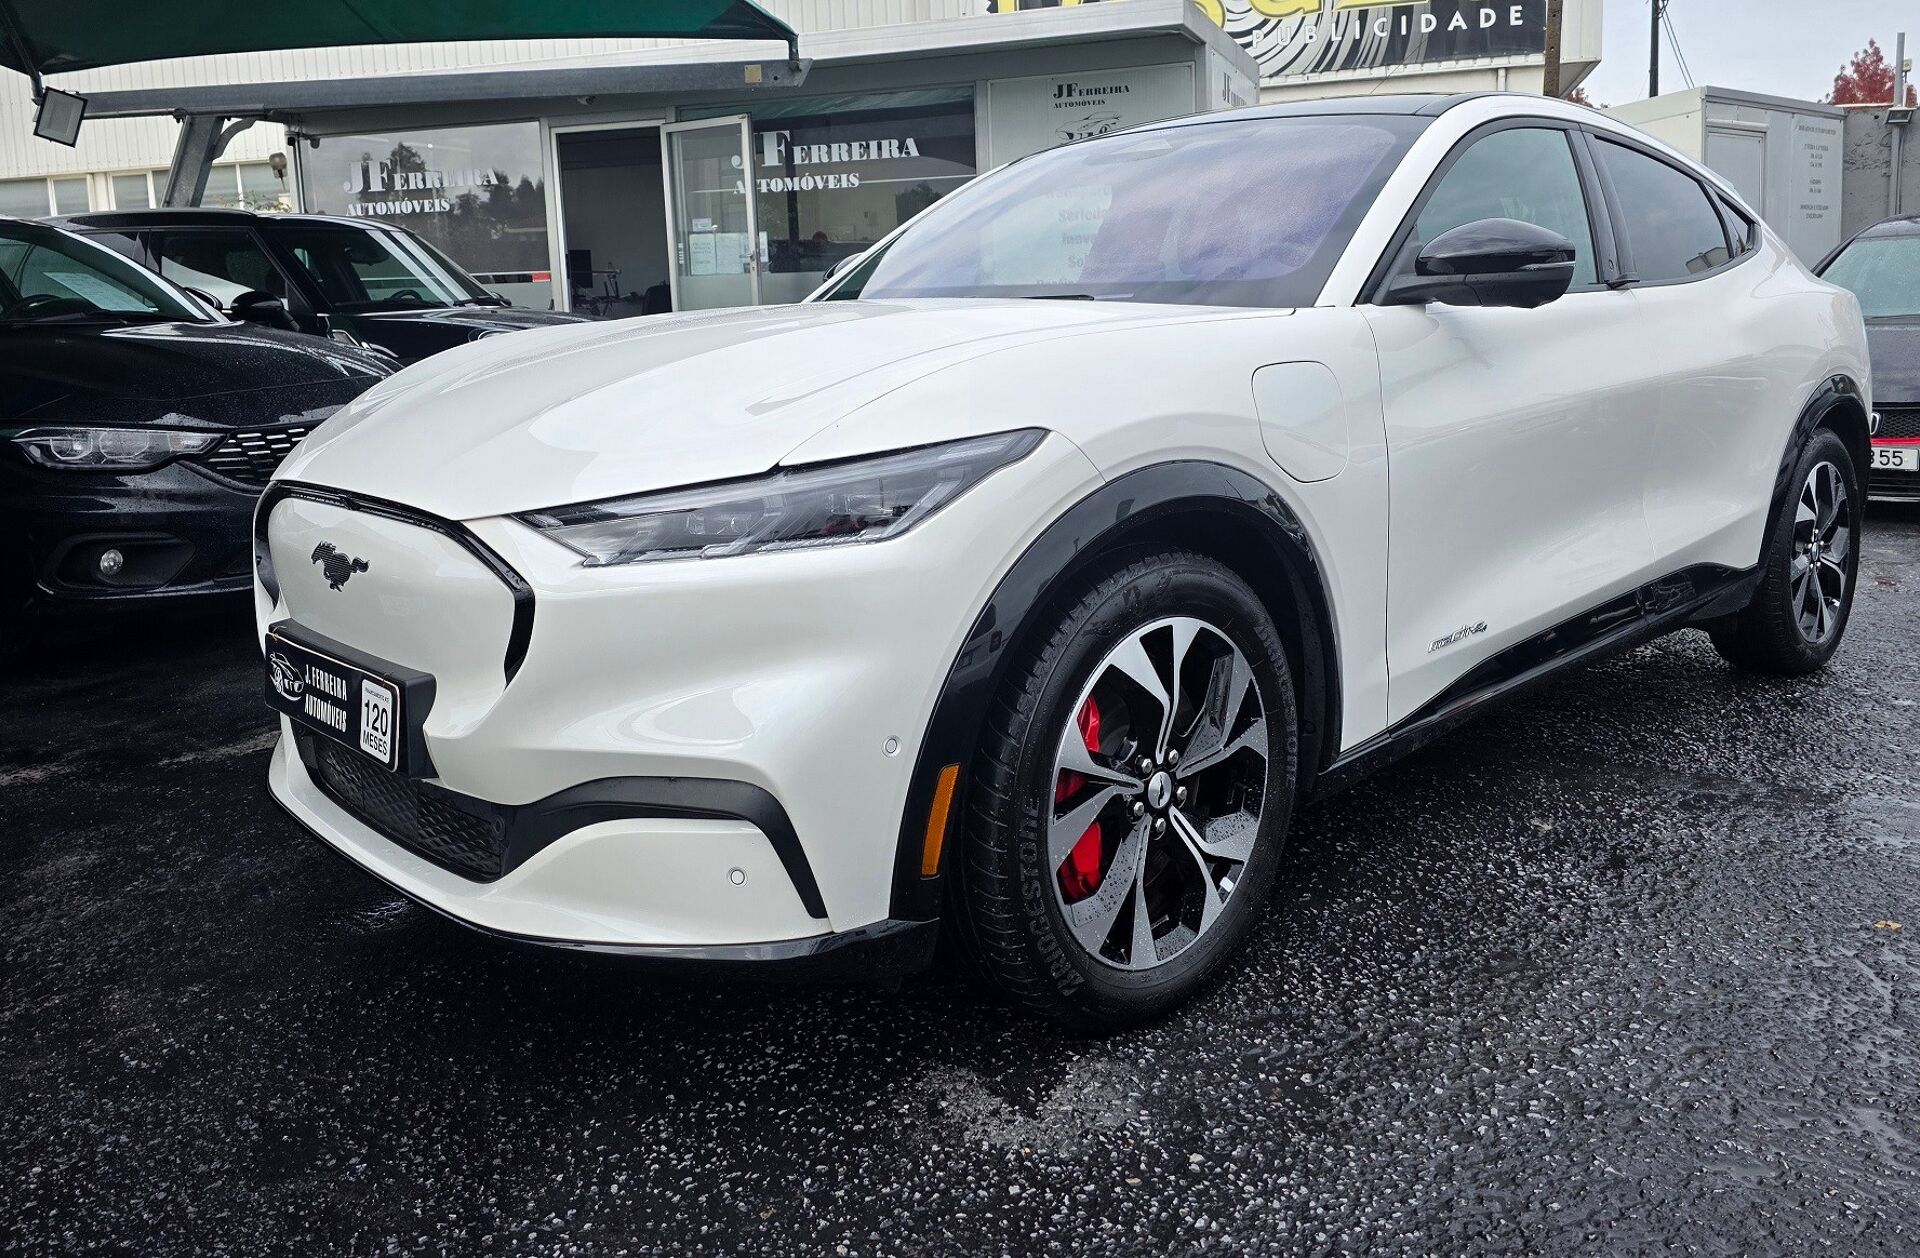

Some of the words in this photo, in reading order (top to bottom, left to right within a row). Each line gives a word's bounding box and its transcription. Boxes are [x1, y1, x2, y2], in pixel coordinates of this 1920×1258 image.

[1252, 5, 1524, 49] PUBLICIDADE
[733, 172, 860, 195] ATOMÓVEIS
[346, 197, 451, 217] AUTOMÓVEIS
[311, 667, 347, 701] FERREIRA
[304, 693, 347, 733] AUTOMÓVEIS
[364, 699, 388, 737] 120
[362, 729, 388, 756] MESES
